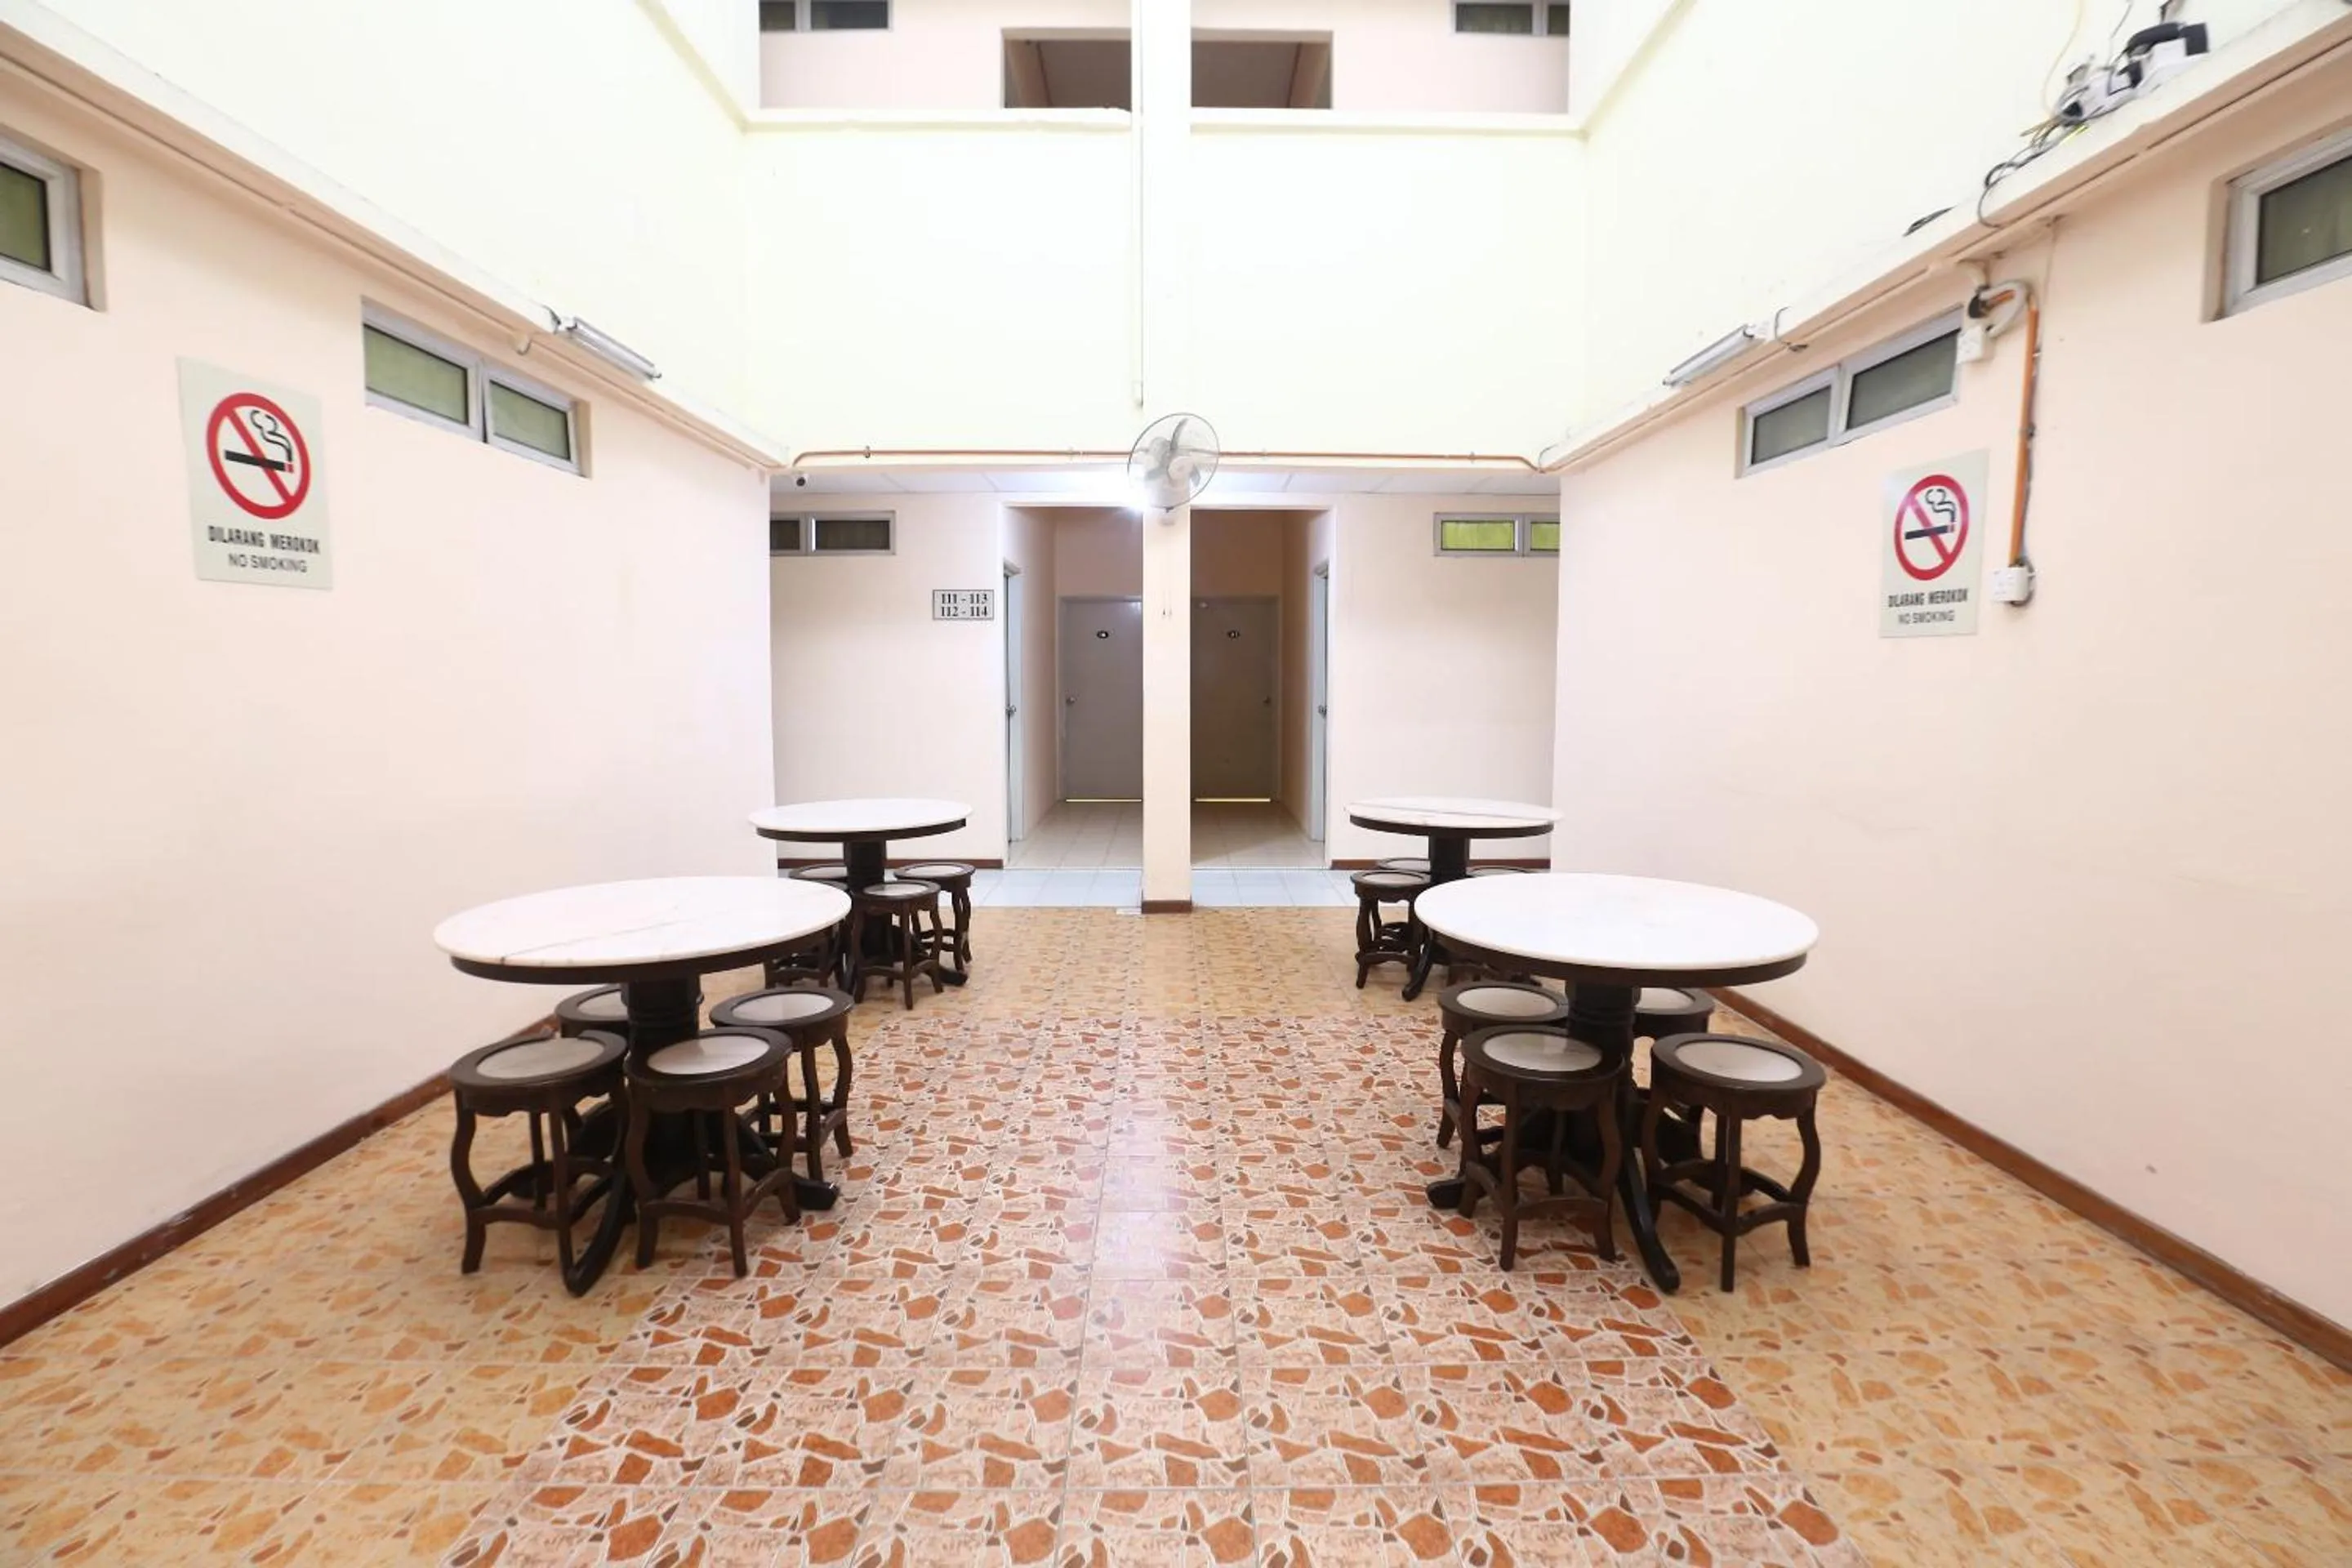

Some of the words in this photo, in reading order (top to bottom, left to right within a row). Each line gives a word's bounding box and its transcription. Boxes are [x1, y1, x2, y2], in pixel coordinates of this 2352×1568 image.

[207, 525, 265, 548] DILARANG
[270, 533, 320, 555] MEROKOK
[228, 553, 247, 568] NO
[250, 555, 308, 572] SMOKING
[941, 594, 957, 604] 111
[969, 594, 987, 604] 113
[941, 606, 959, 617] 112
[970, 606, 987, 617] 114
